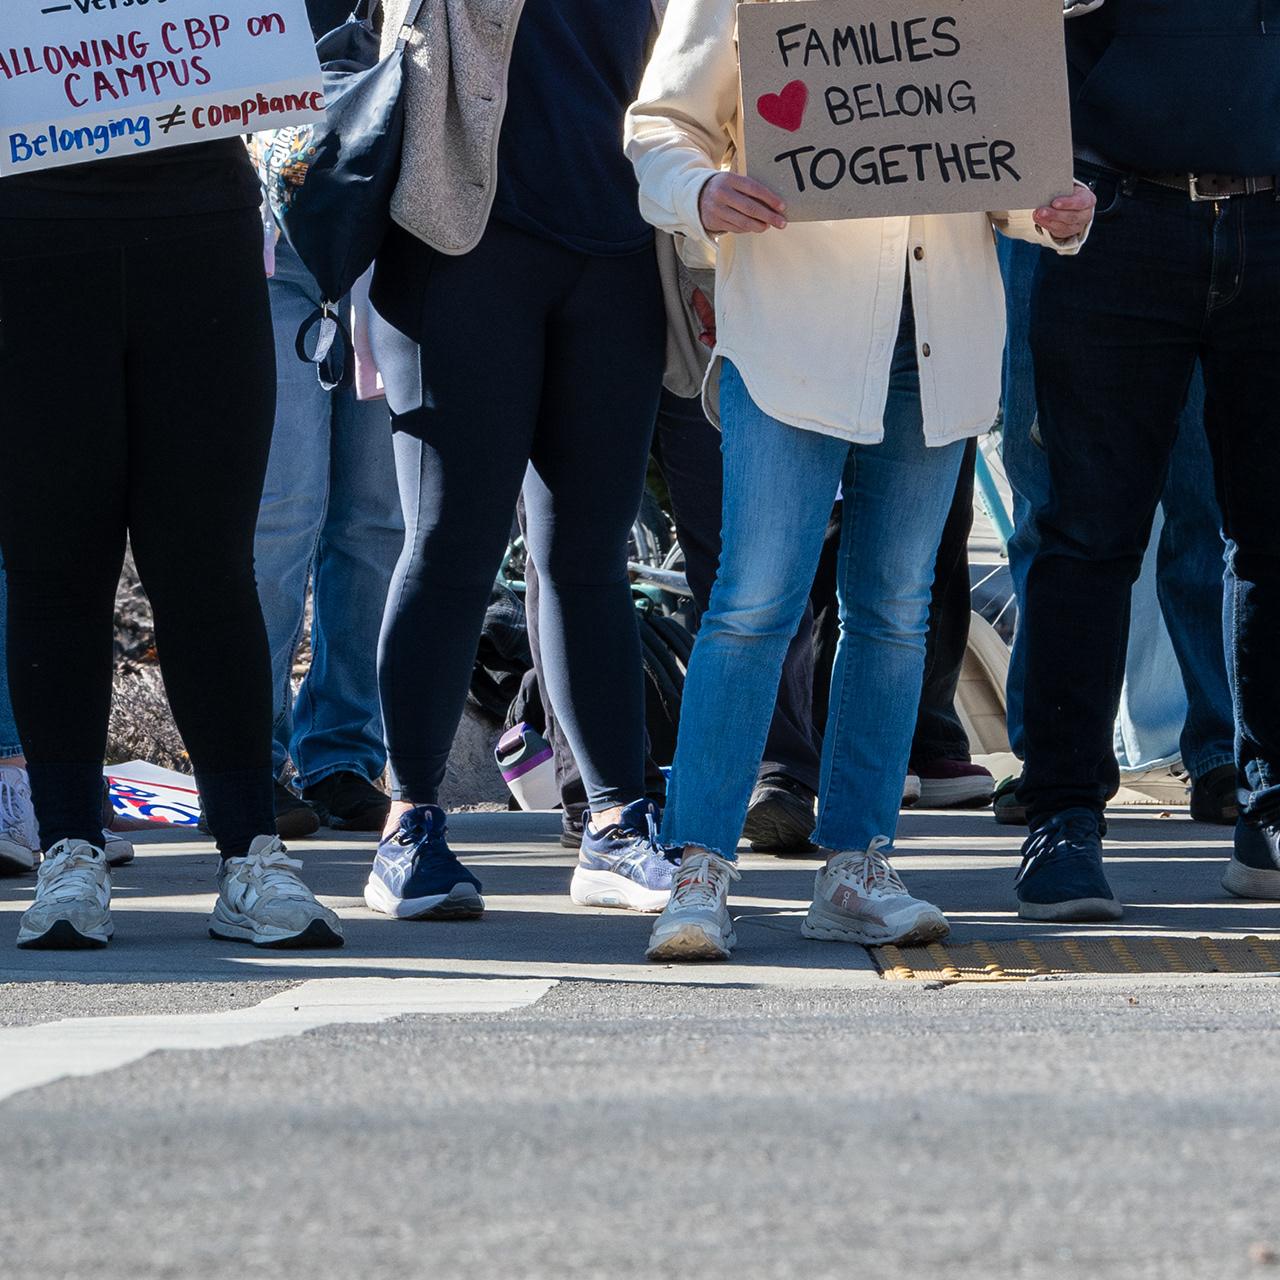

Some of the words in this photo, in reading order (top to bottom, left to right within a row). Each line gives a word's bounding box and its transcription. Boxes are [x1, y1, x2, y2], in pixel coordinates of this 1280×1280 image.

[162, 13, 231, 54] CBP
[248, 13, 285, 37] on
[776, 16, 961, 67] FAMILIES
[65, 56, 211, 108] CAMPUS
[824, 80, 976, 125] BELONG
[10, 115, 151, 164] Belonging
[192, 91, 326, 129] compliance
[775, 140, 1021, 192] TOGETHER
